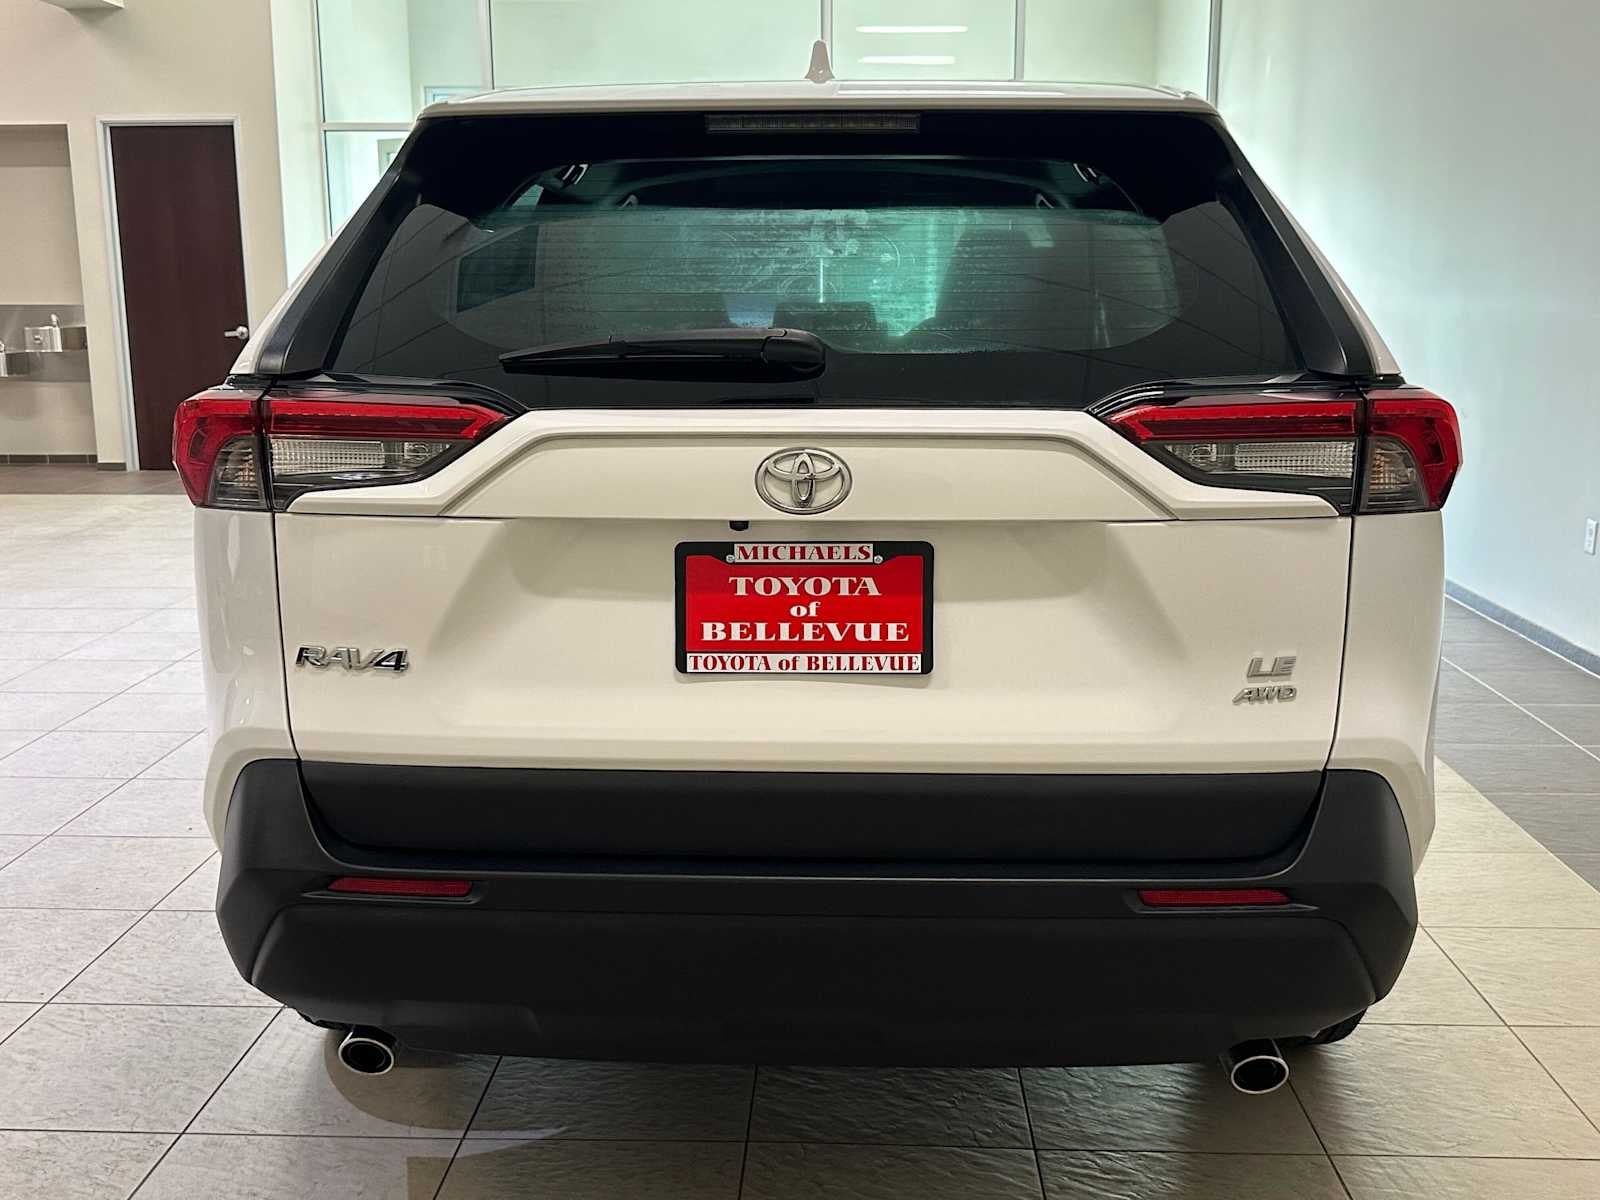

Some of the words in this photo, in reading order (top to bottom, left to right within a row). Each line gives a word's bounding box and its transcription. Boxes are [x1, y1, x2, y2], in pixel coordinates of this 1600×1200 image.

[737, 545, 871, 561] MICHAELS
[729, 576, 881, 596] TOYOTA
[790, 601, 821, 618] of
[701, 622, 910, 642] BELLEVUE
[296, 646, 408, 672] RAV4
[689, 655, 771, 671] TOYOTA
[778, 654, 799, 671] of
[807, 655, 919, 671] BELLEVUE
[1247, 656, 1296, 680] LE
[1232, 686, 1297, 704] AWD
